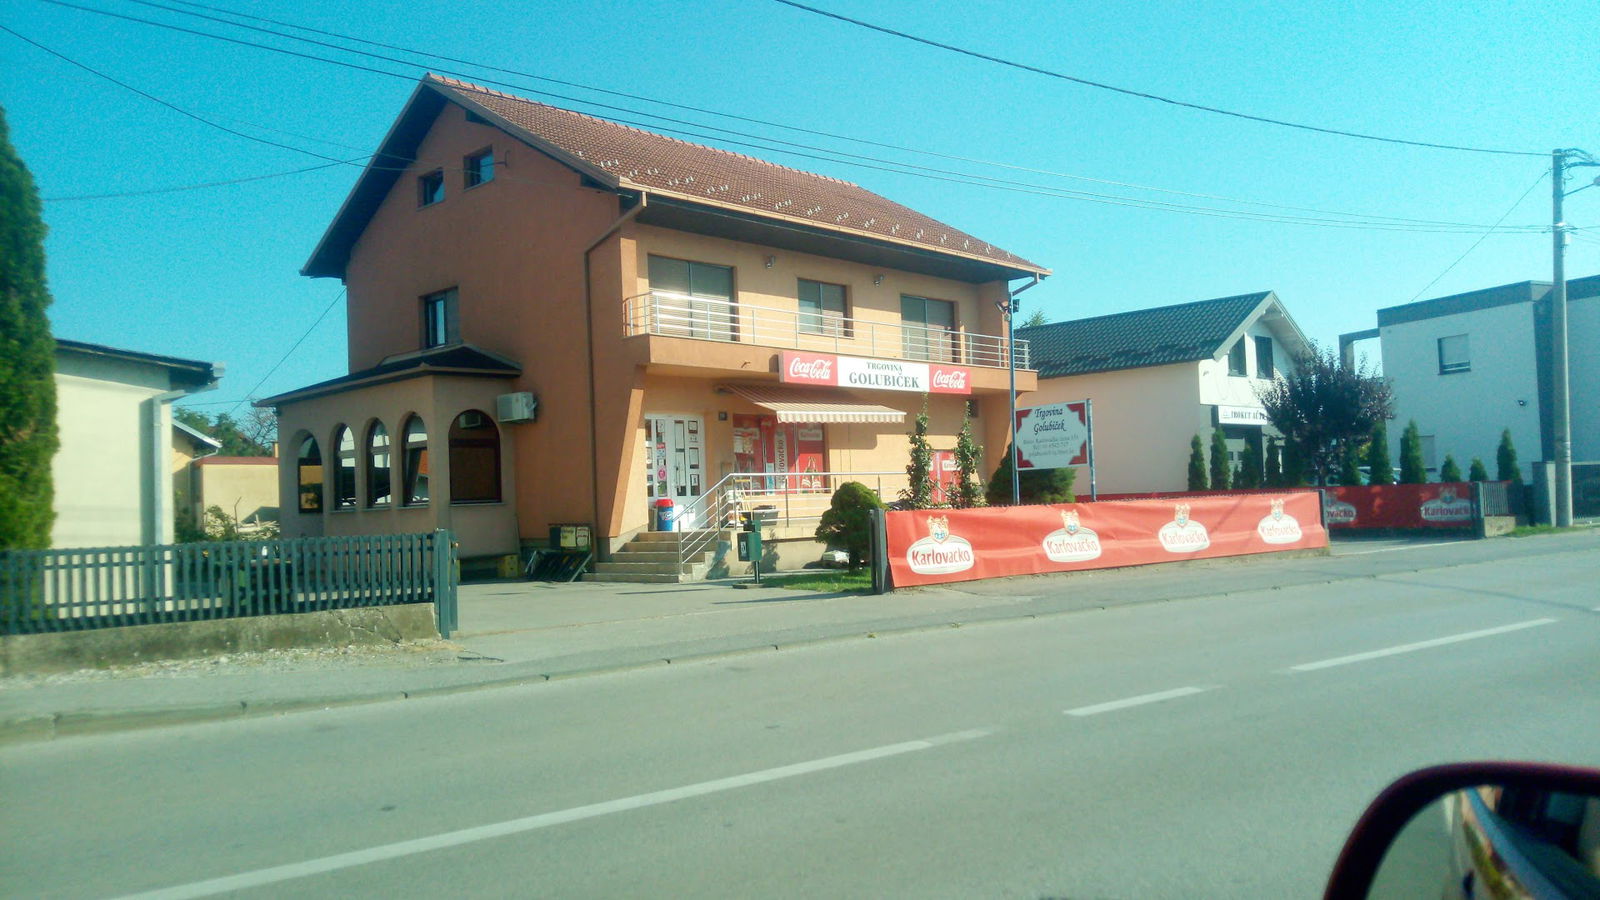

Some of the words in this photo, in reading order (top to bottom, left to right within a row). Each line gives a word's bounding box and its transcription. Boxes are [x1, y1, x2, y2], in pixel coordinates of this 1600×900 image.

[866, 362, 903, 373] TRGOVINA
[849, 371, 919, 388] GOLUBIČEK
[1035, 406, 1063, 420] Trgovina
